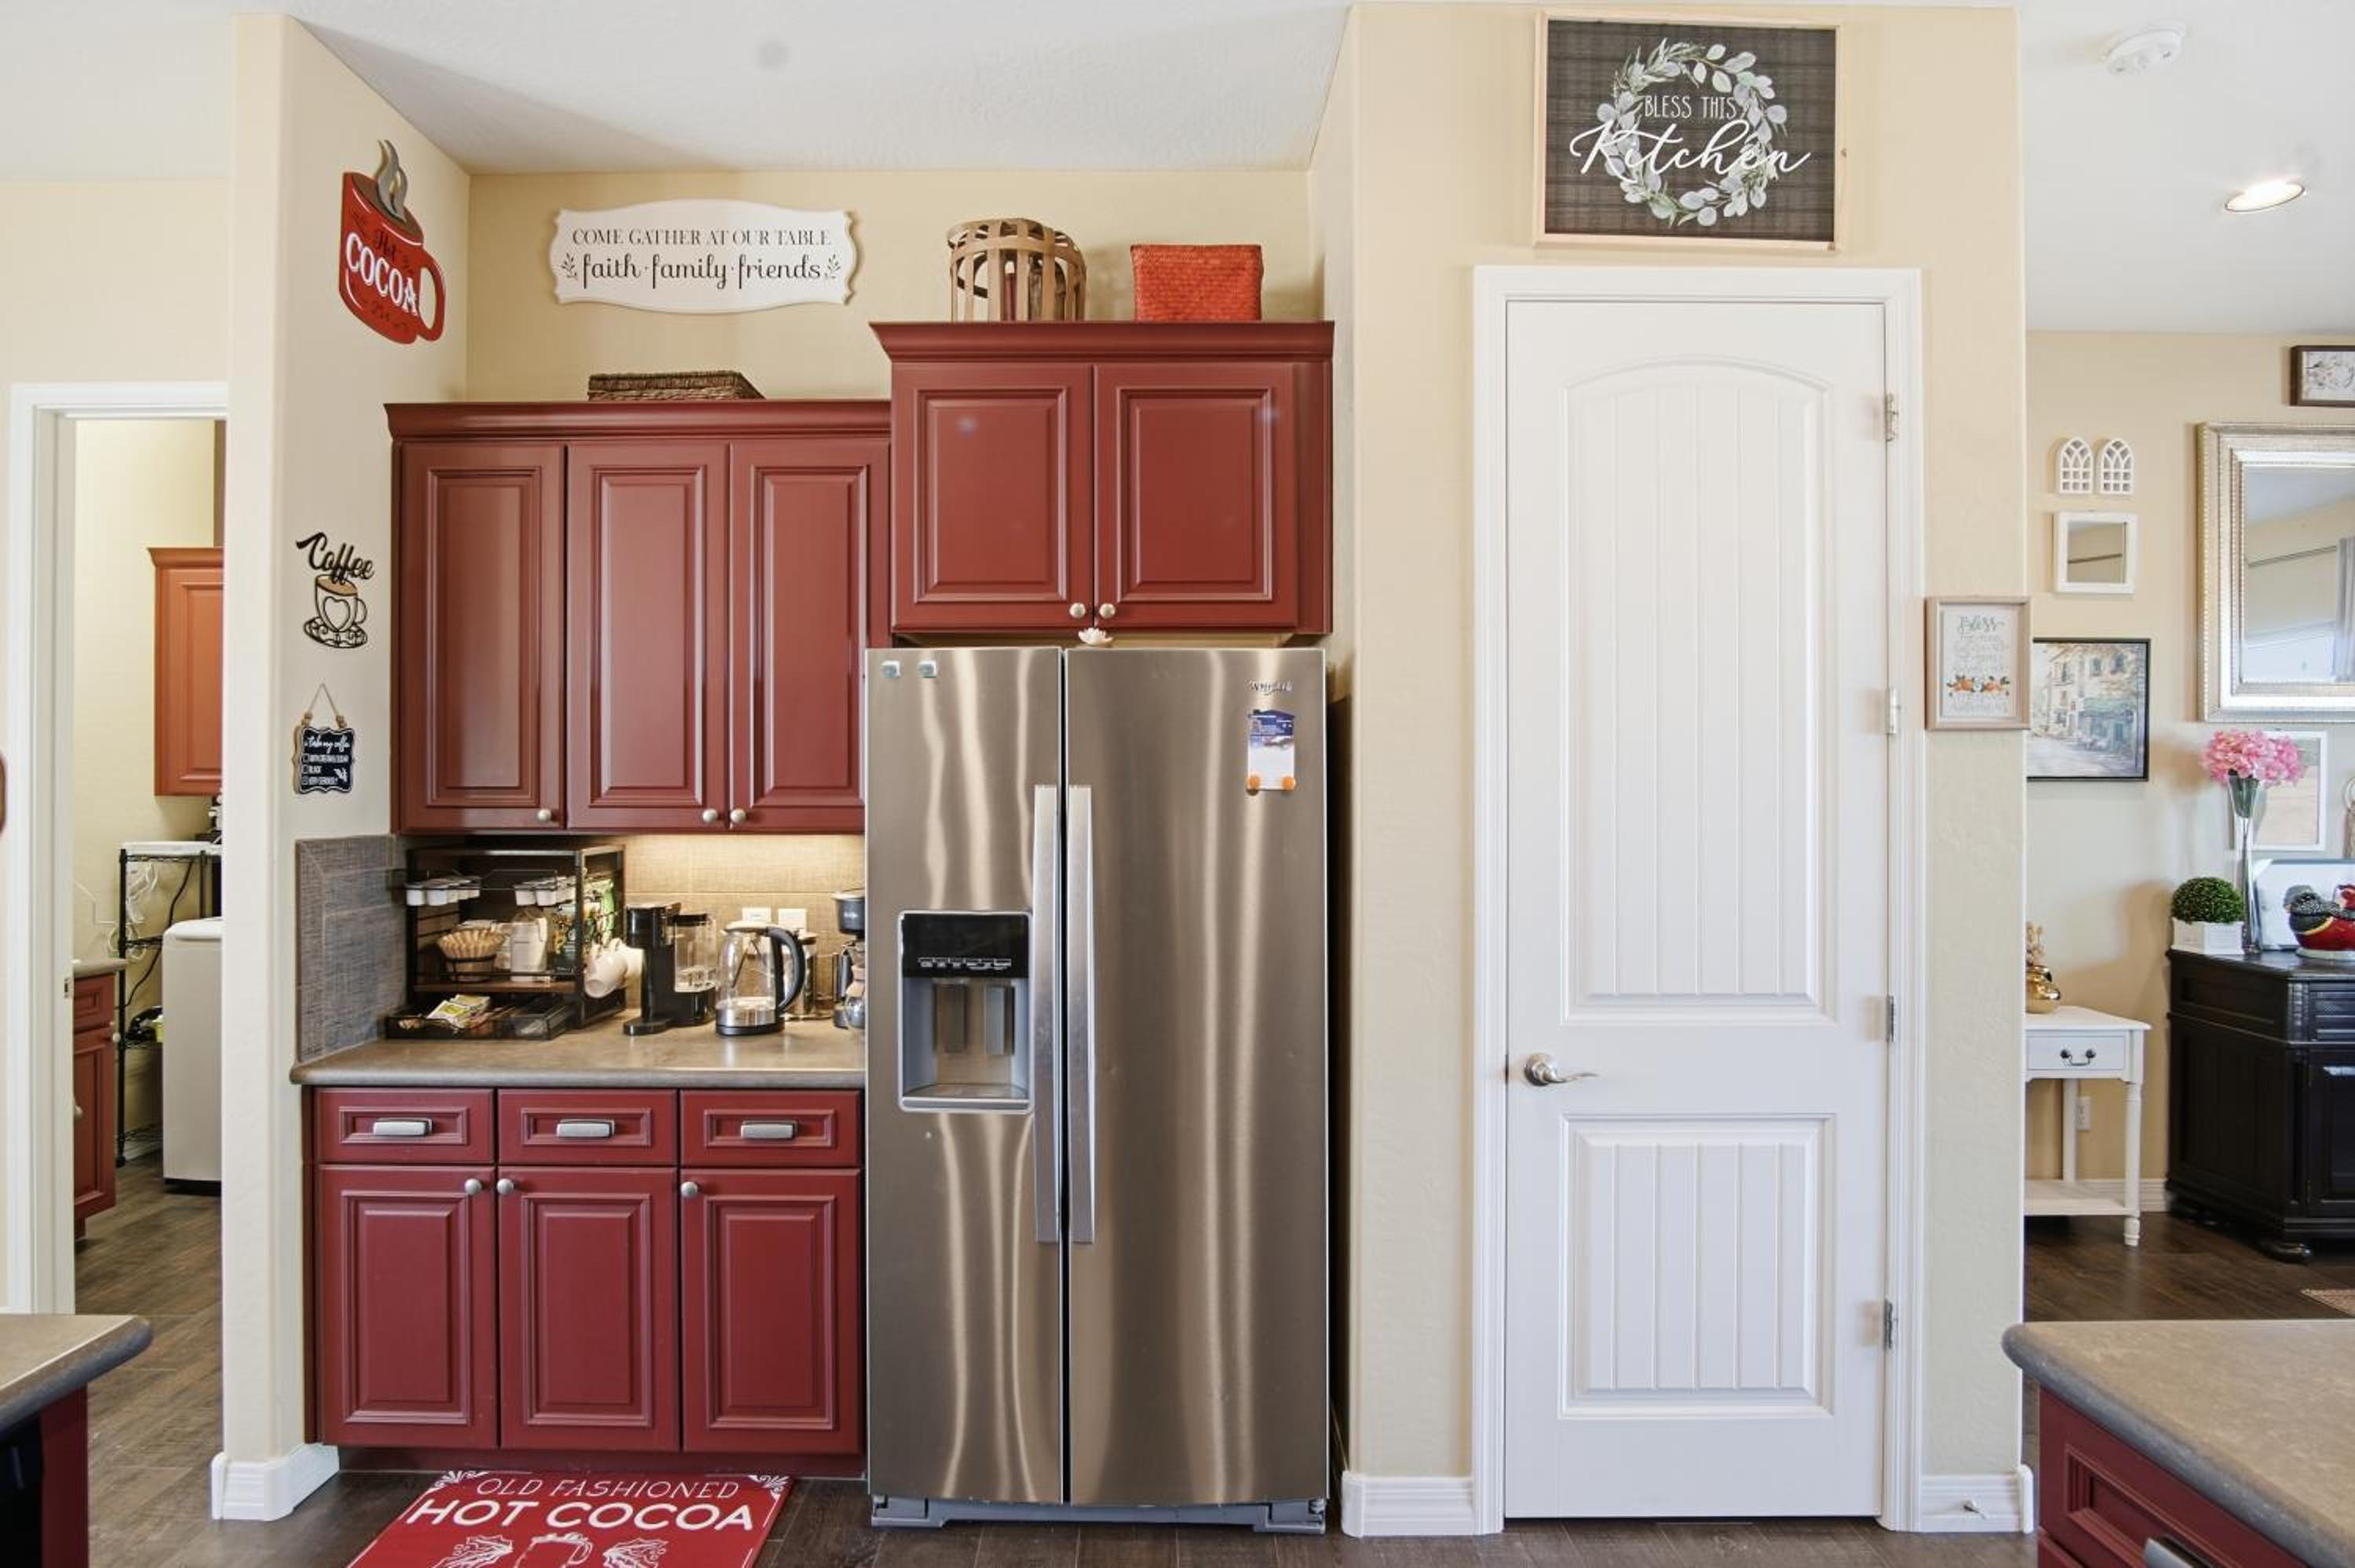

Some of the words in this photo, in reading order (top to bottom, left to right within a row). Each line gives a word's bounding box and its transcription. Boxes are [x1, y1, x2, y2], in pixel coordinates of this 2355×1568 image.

[1645, 95, 1692, 119] BLESS
[1701, 97, 1738, 121] THIS
[1569, 119, 1812, 184] Kitchen
[572, 228, 625, 246] COME
[628, 228, 703, 246] GATHER
[706, 228, 730, 246] AT
[732, 228, 770, 246] OUR
[774, 228, 832, 246] TABLE
[345, 232, 418, 316] COCOA
[582, 252, 641, 290] faith
[652, 252, 728, 290] family
[738, 252, 822, 290] friends
[295, 532, 375, 585] Coffee
[475, 1478, 544, 1497] OLD
[550, 1479, 740, 1500] FASHIONED
[405, 1499, 540, 1528] HOT
[545, 1502, 754, 1531] COCOA
